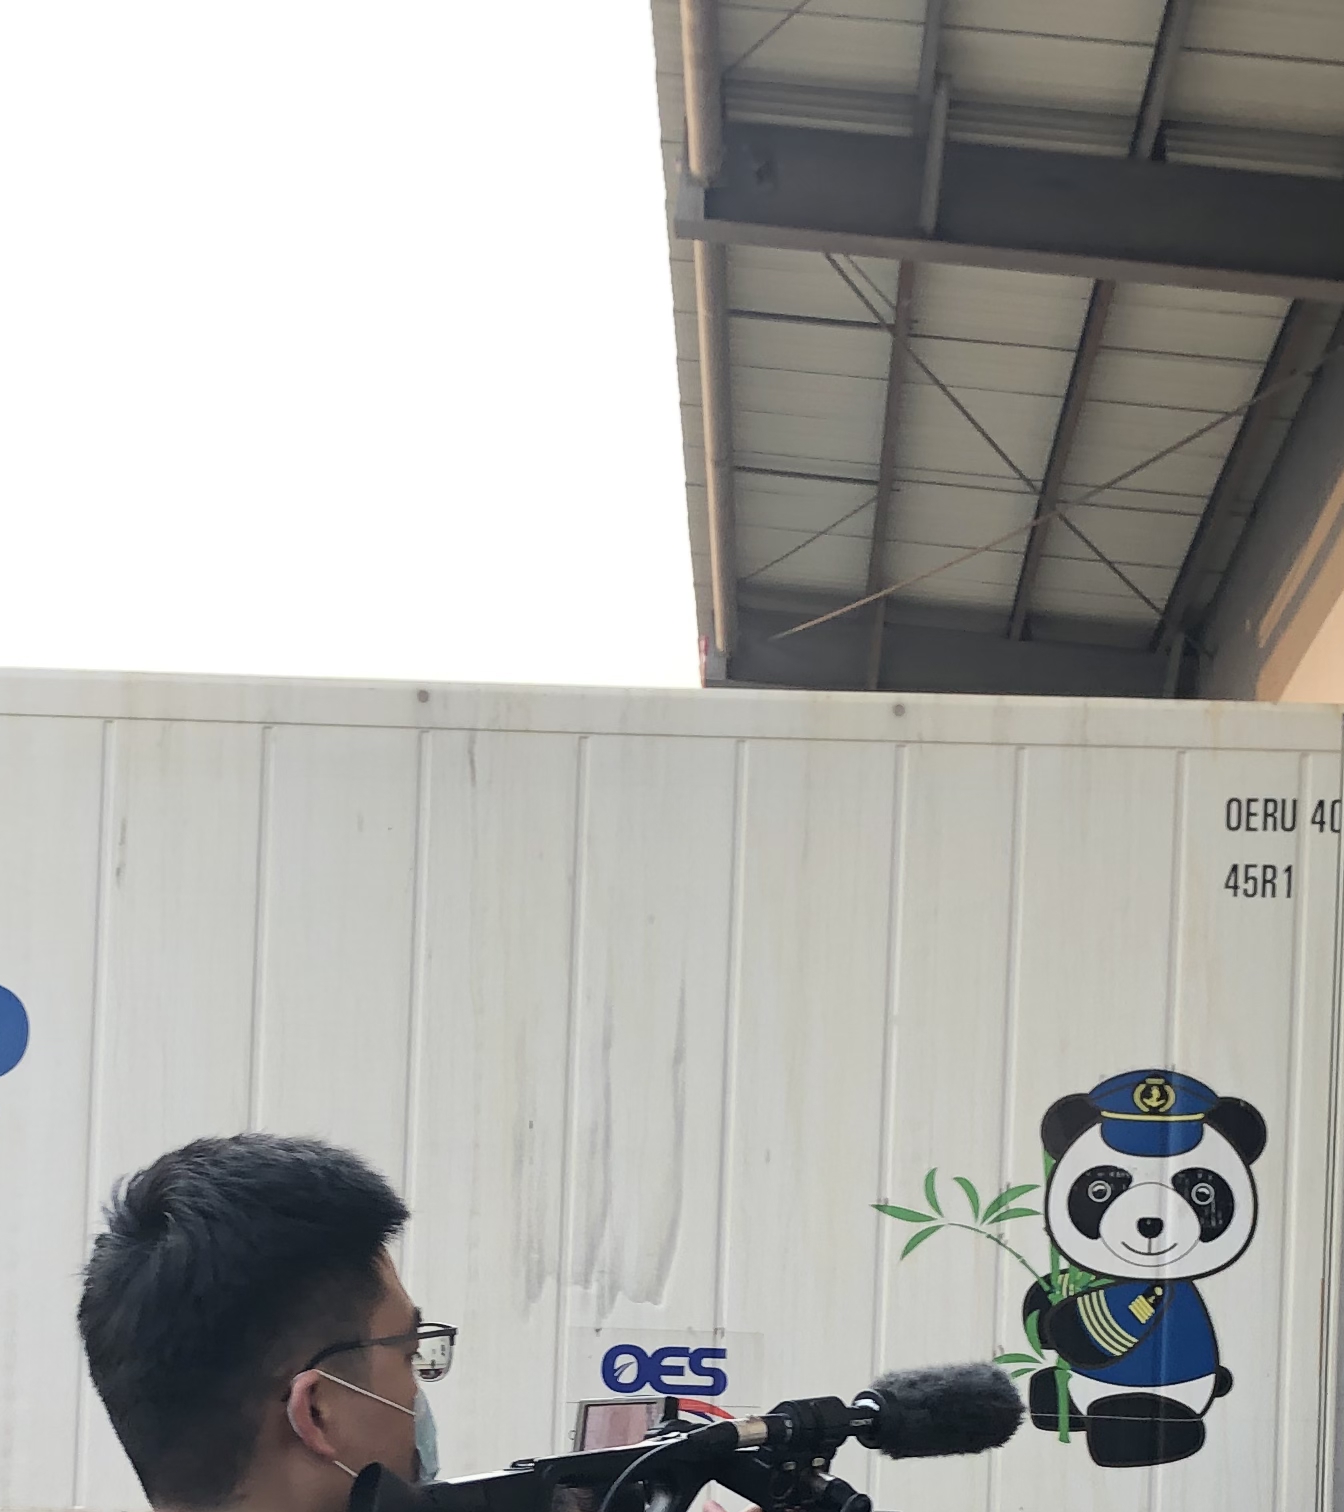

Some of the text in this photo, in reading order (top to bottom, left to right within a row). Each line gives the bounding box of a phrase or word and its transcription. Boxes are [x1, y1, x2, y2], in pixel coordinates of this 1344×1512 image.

[1225, 797, 1298, 833] OERU
[1223, 863, 1294, 899] 45R1
[601, 1343, 728, 1397] OES
